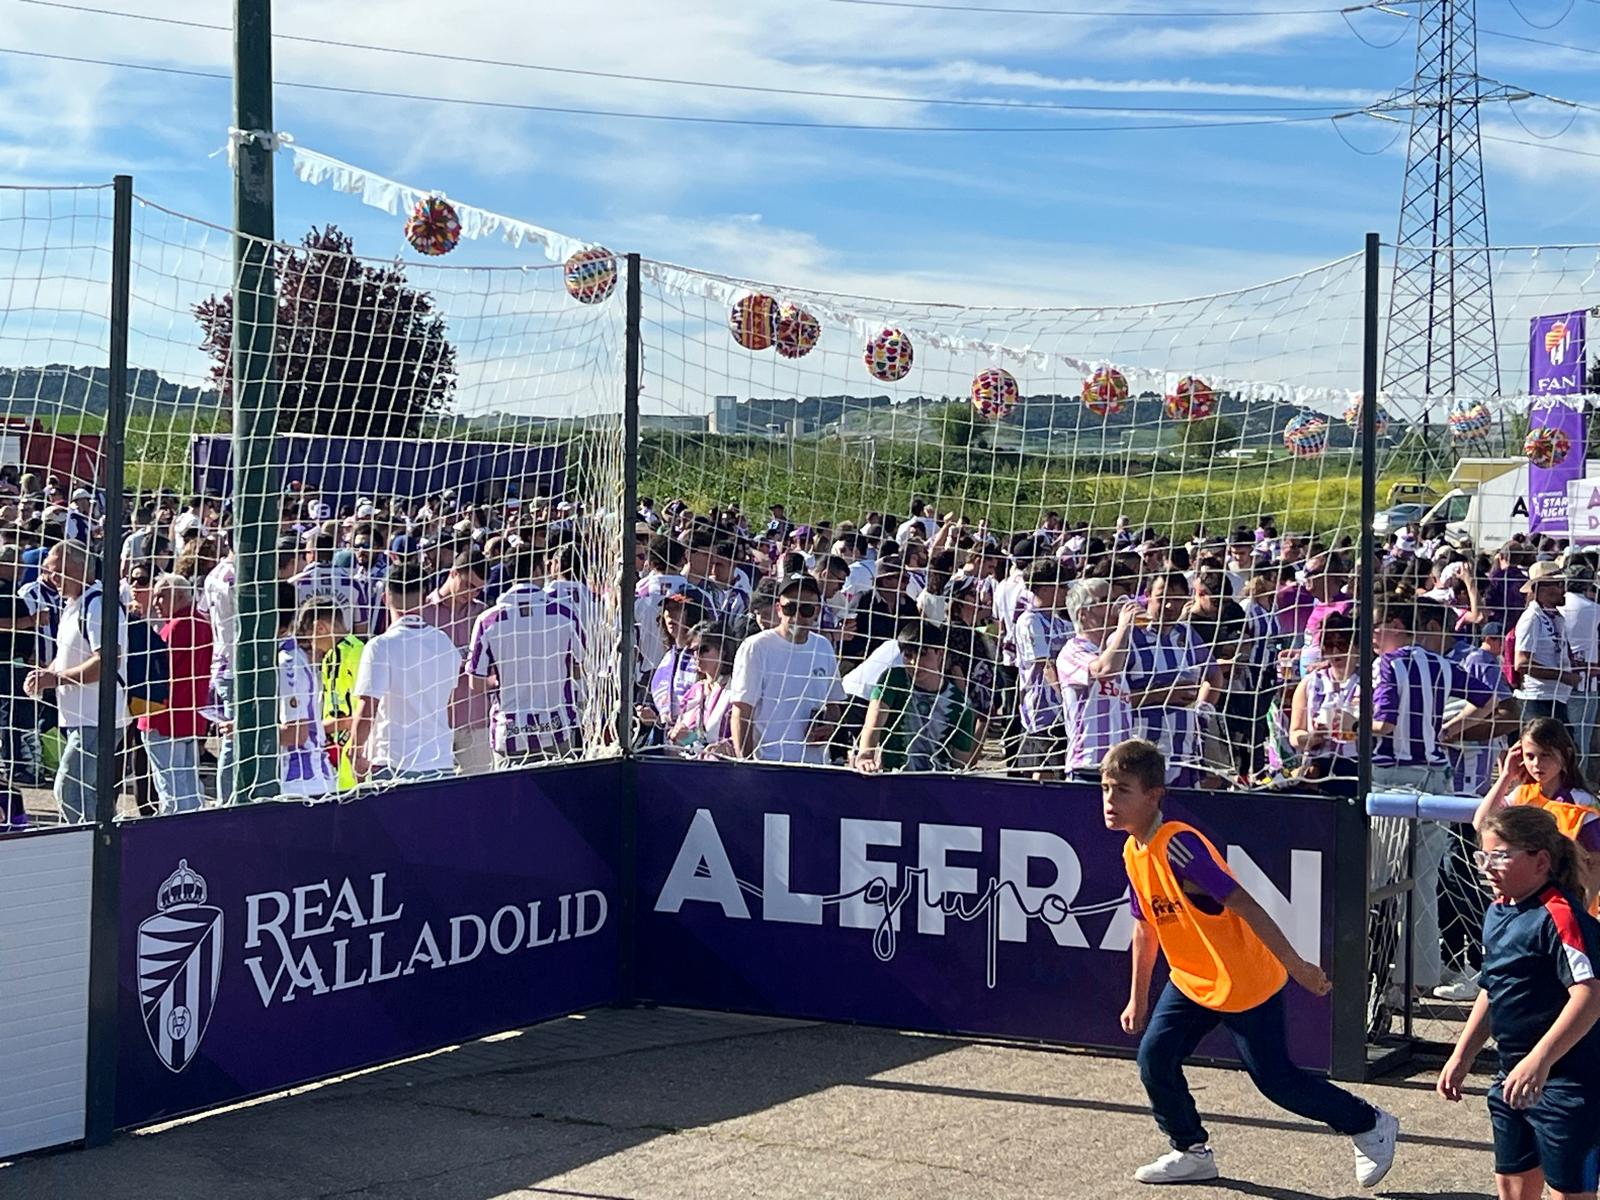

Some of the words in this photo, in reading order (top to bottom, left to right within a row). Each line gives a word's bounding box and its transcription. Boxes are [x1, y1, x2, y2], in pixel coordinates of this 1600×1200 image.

[1538, 374, 1576, 391] FAN
[244, 872, 404, 950] REAL
[244, 889, 608, 1008] VALLADOLID
[859, 866, 1074, 988] grupo
